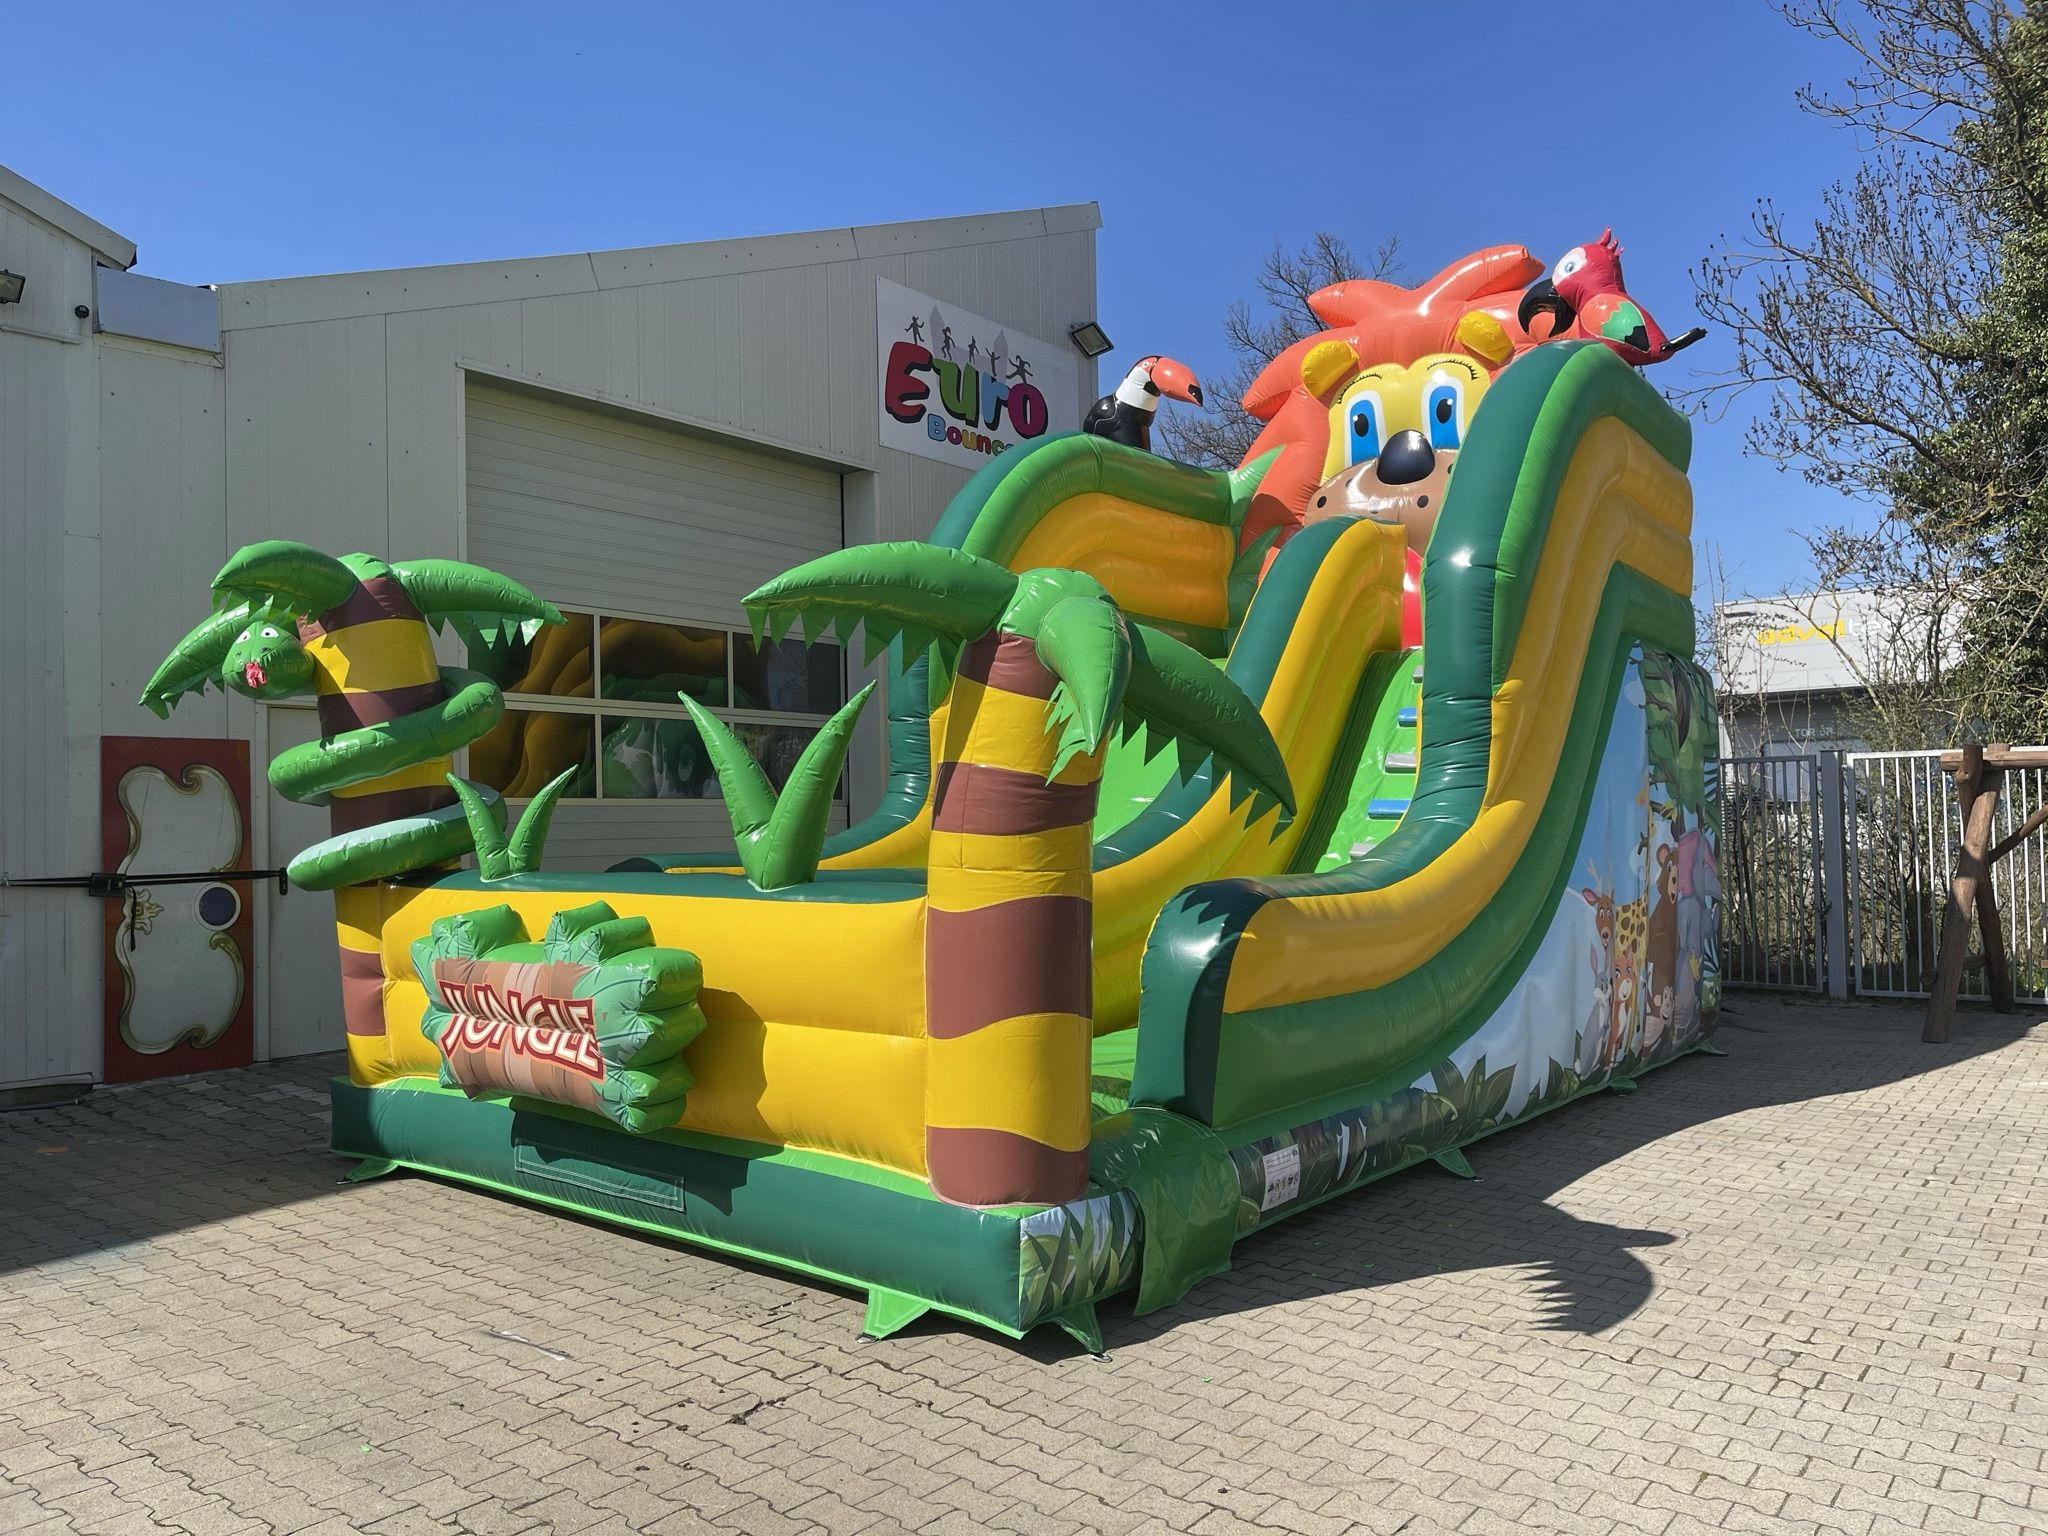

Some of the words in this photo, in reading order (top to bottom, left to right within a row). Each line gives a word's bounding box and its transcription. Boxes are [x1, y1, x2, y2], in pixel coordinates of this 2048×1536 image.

[884, 341, 1048, 439] Euro
[927, 413, 1015, 457] Bounc
[438, 979, 606, 1081] JUNGLE
